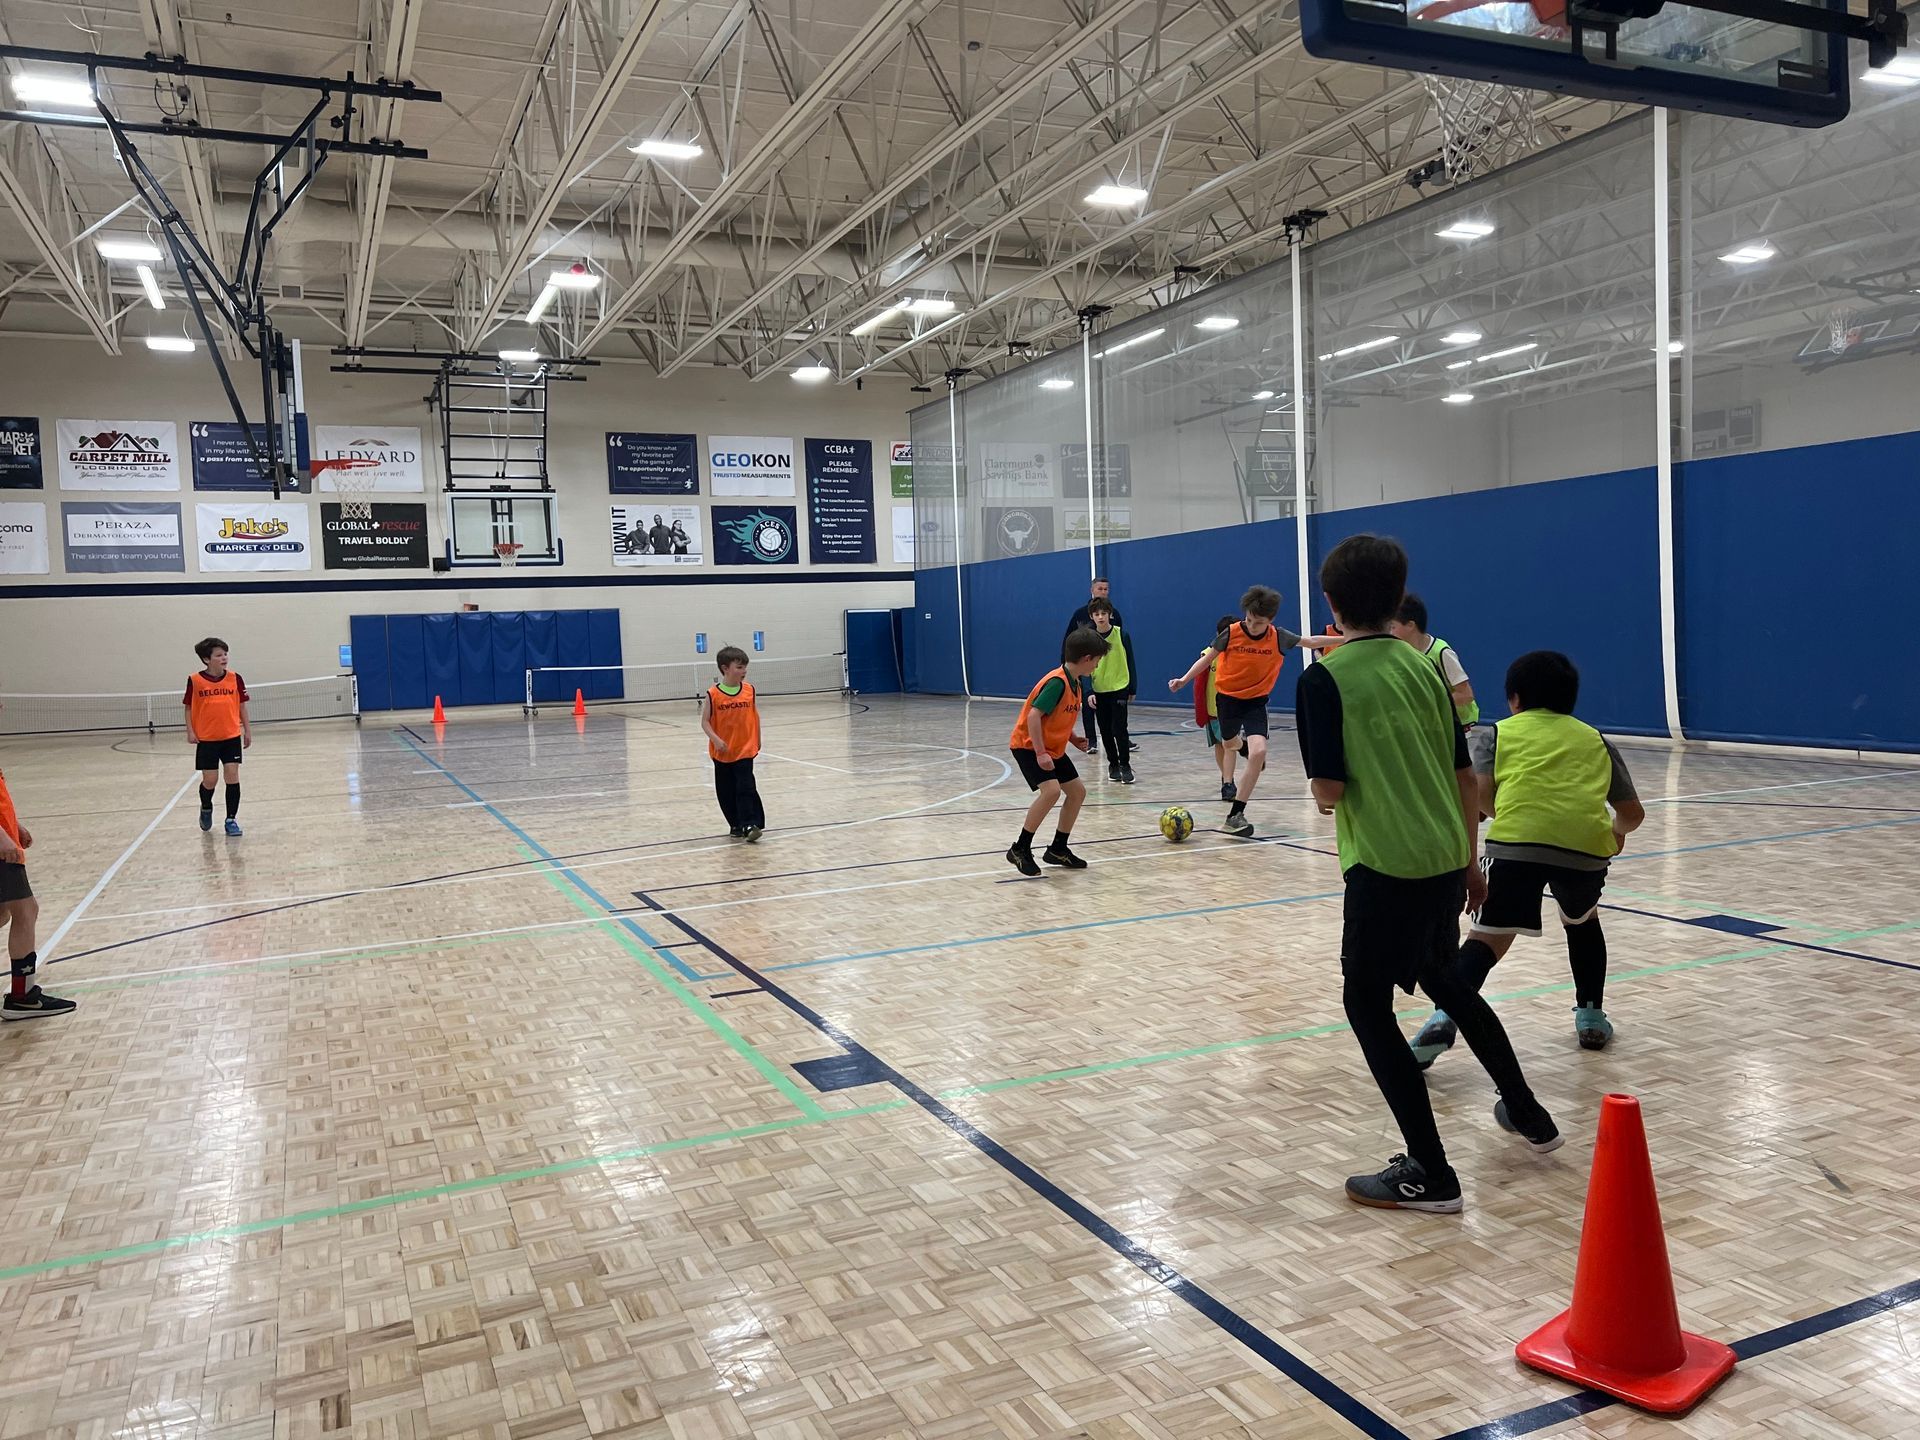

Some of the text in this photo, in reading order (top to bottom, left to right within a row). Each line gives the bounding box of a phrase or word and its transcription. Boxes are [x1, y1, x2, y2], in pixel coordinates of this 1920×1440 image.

[824, 445, 849, 454] CCBA
[69, 452, 171, 463] CARPET MILL
[712, 453, 791, 468] GEOKON
[984, 458, 1033, 469] Claremont
[986, 470, 1048, 482] Savings Bank
[611, 506, 626, 518] IT
[218, 518, 289, 539] Jake's
[326, 521, 420, 531] GLOBAL rescue
[760, 521, 780, 530] ACES
[613, 522, 628, 553] OWN
[144, 553, 159, 562] you
[198, 689, 234, 697] BELGIUM
